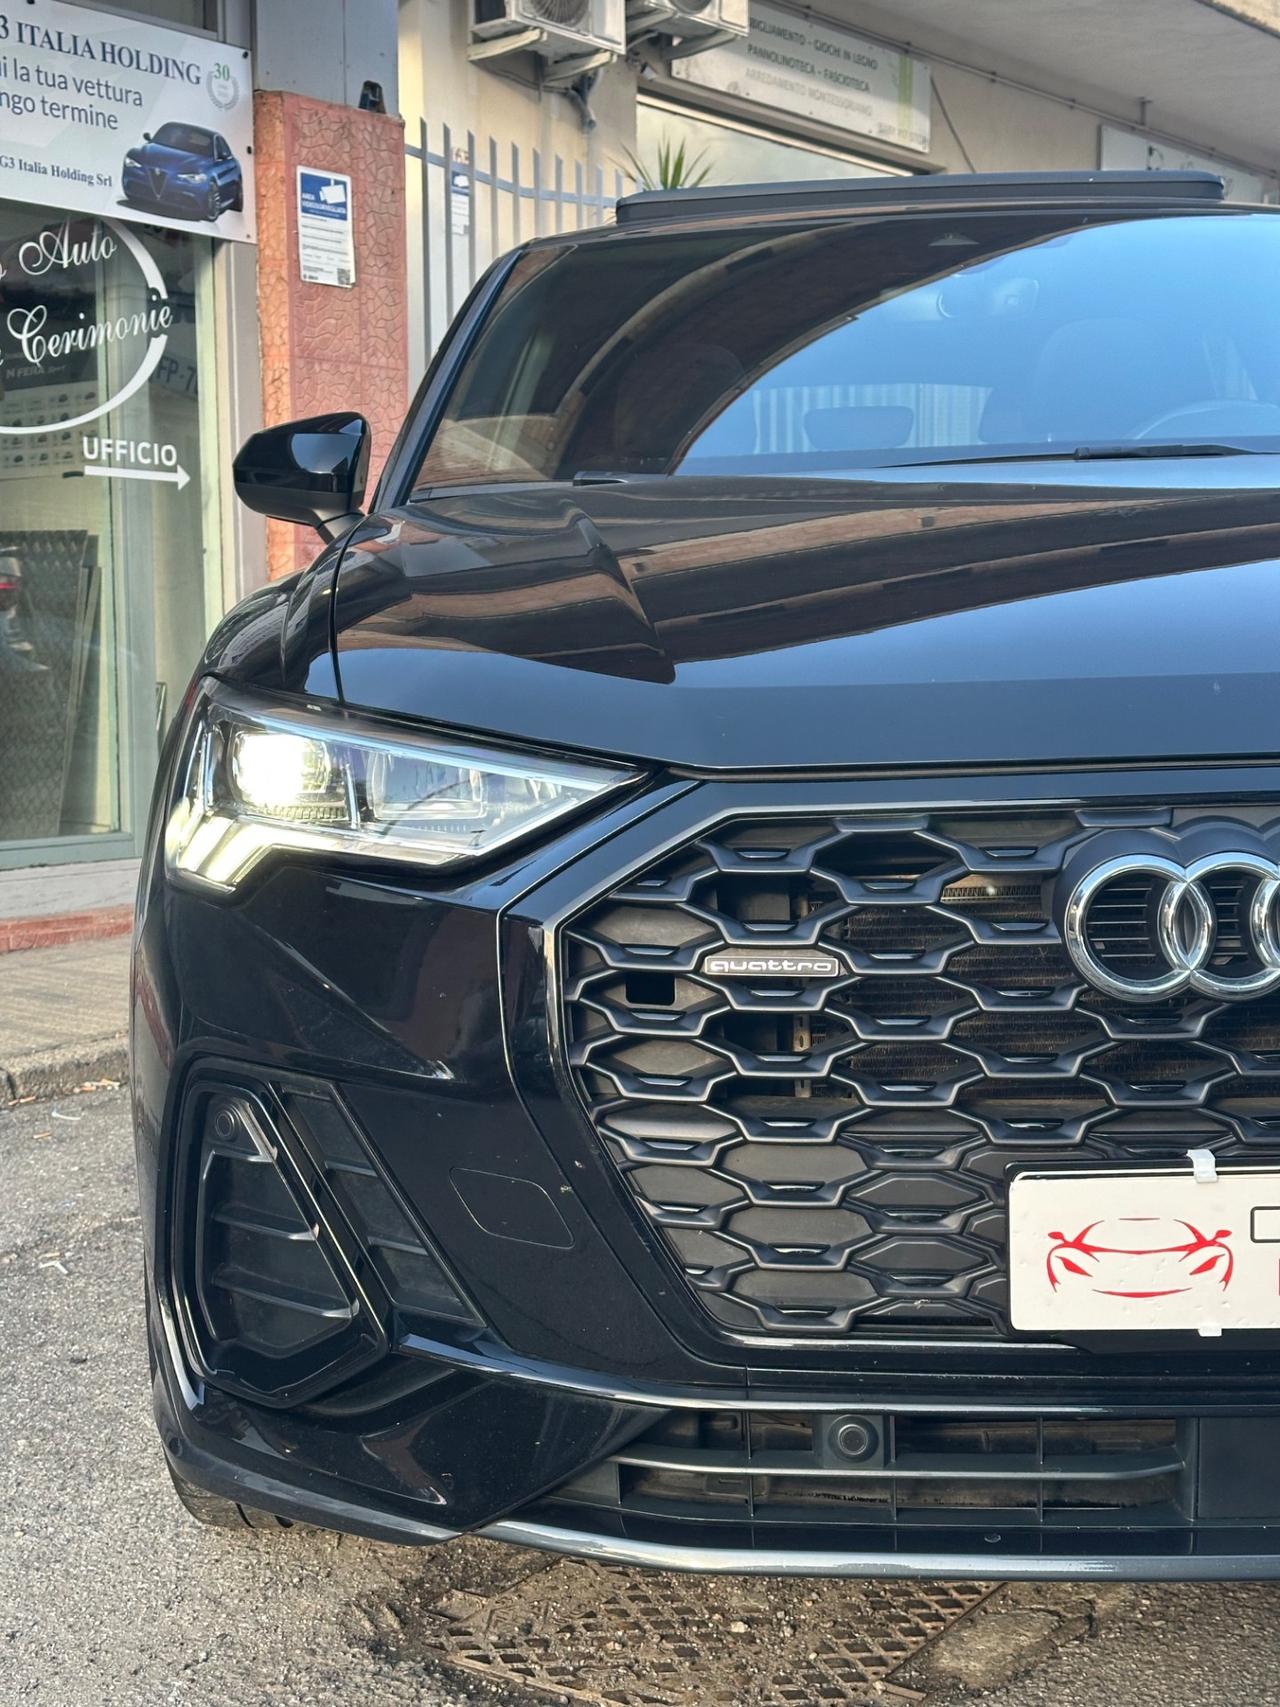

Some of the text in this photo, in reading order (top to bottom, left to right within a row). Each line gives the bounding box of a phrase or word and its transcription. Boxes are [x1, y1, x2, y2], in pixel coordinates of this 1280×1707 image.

[16, 21, 96, 60] ITALIA
[100, 41, 201, 85] HOLDING
[13, 57, 31, 83] la
[35, 64, 68, 91] tua
[72, 77, 143, 107] vettura
[213, 62, 230, 81] 30
[40, 95, 118, 130] termine
[0, 154, 113, 188] G3 Italia Holding Srl
[19, 217, 117, 275] Auto
[7, 295, 173, 367] Cerimonie
[82, 436, 178, 466] UFFICIO
[710, 959, 832, 973] quattro
